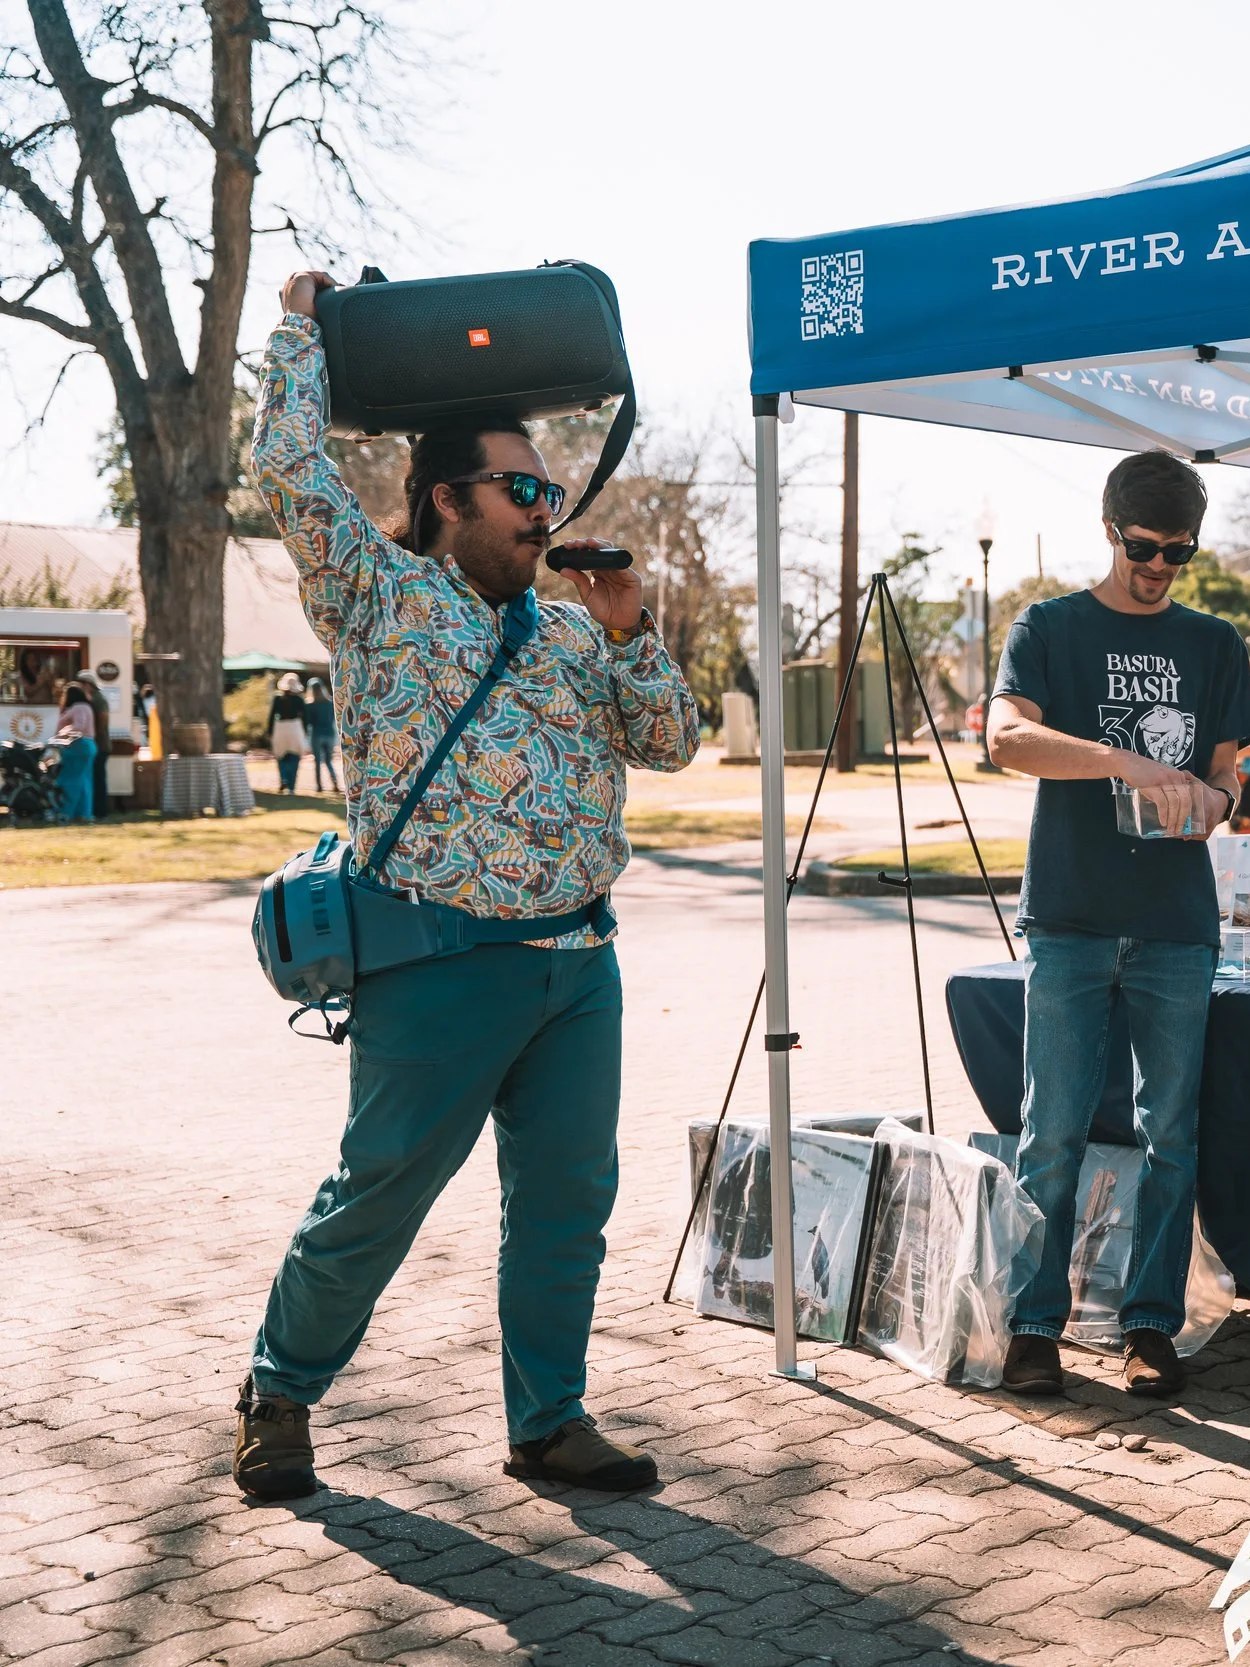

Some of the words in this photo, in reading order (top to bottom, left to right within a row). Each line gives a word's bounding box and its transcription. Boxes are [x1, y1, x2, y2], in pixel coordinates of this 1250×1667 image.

[992, 231, 1185, 290] RIVER
[473, 333, 486, 342] JBL
[1106, 653, 1181, 682] BASURA
[1107, 673, 1181, 703] BASH
